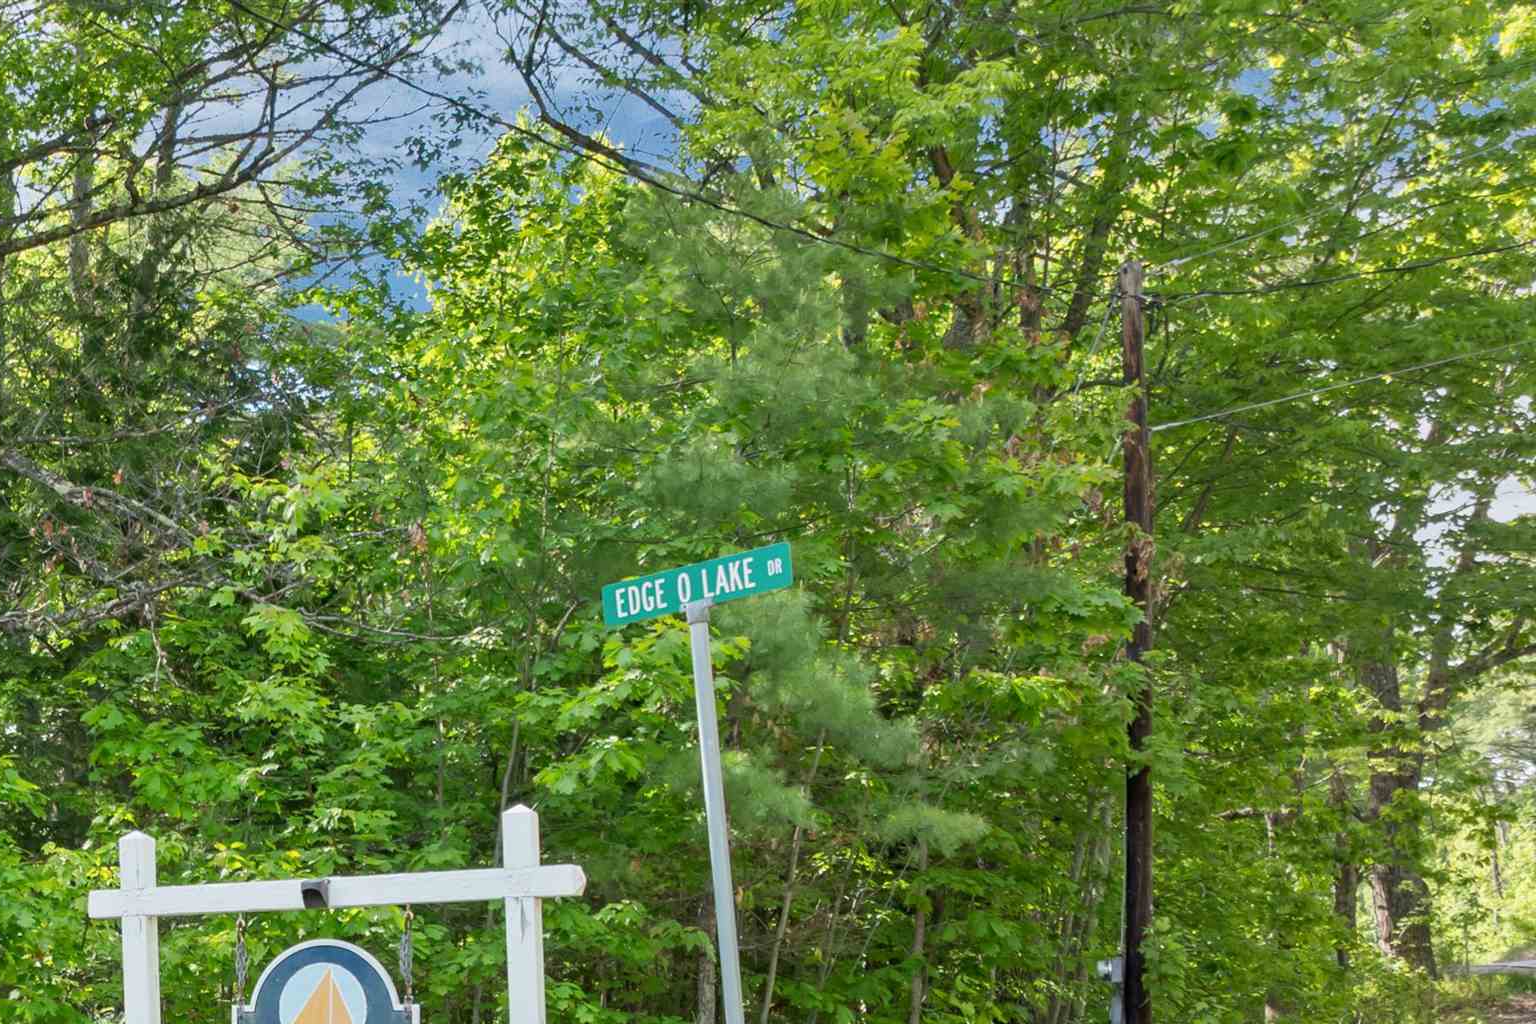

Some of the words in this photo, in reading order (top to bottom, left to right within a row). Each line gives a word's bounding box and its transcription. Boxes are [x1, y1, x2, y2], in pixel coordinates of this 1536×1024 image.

[615, 578, 668, 619] EDGE
[677, 572, 691, 604] O
[701, 557, 756, 598] LAKE
[767, 558, 783, 577] DR
